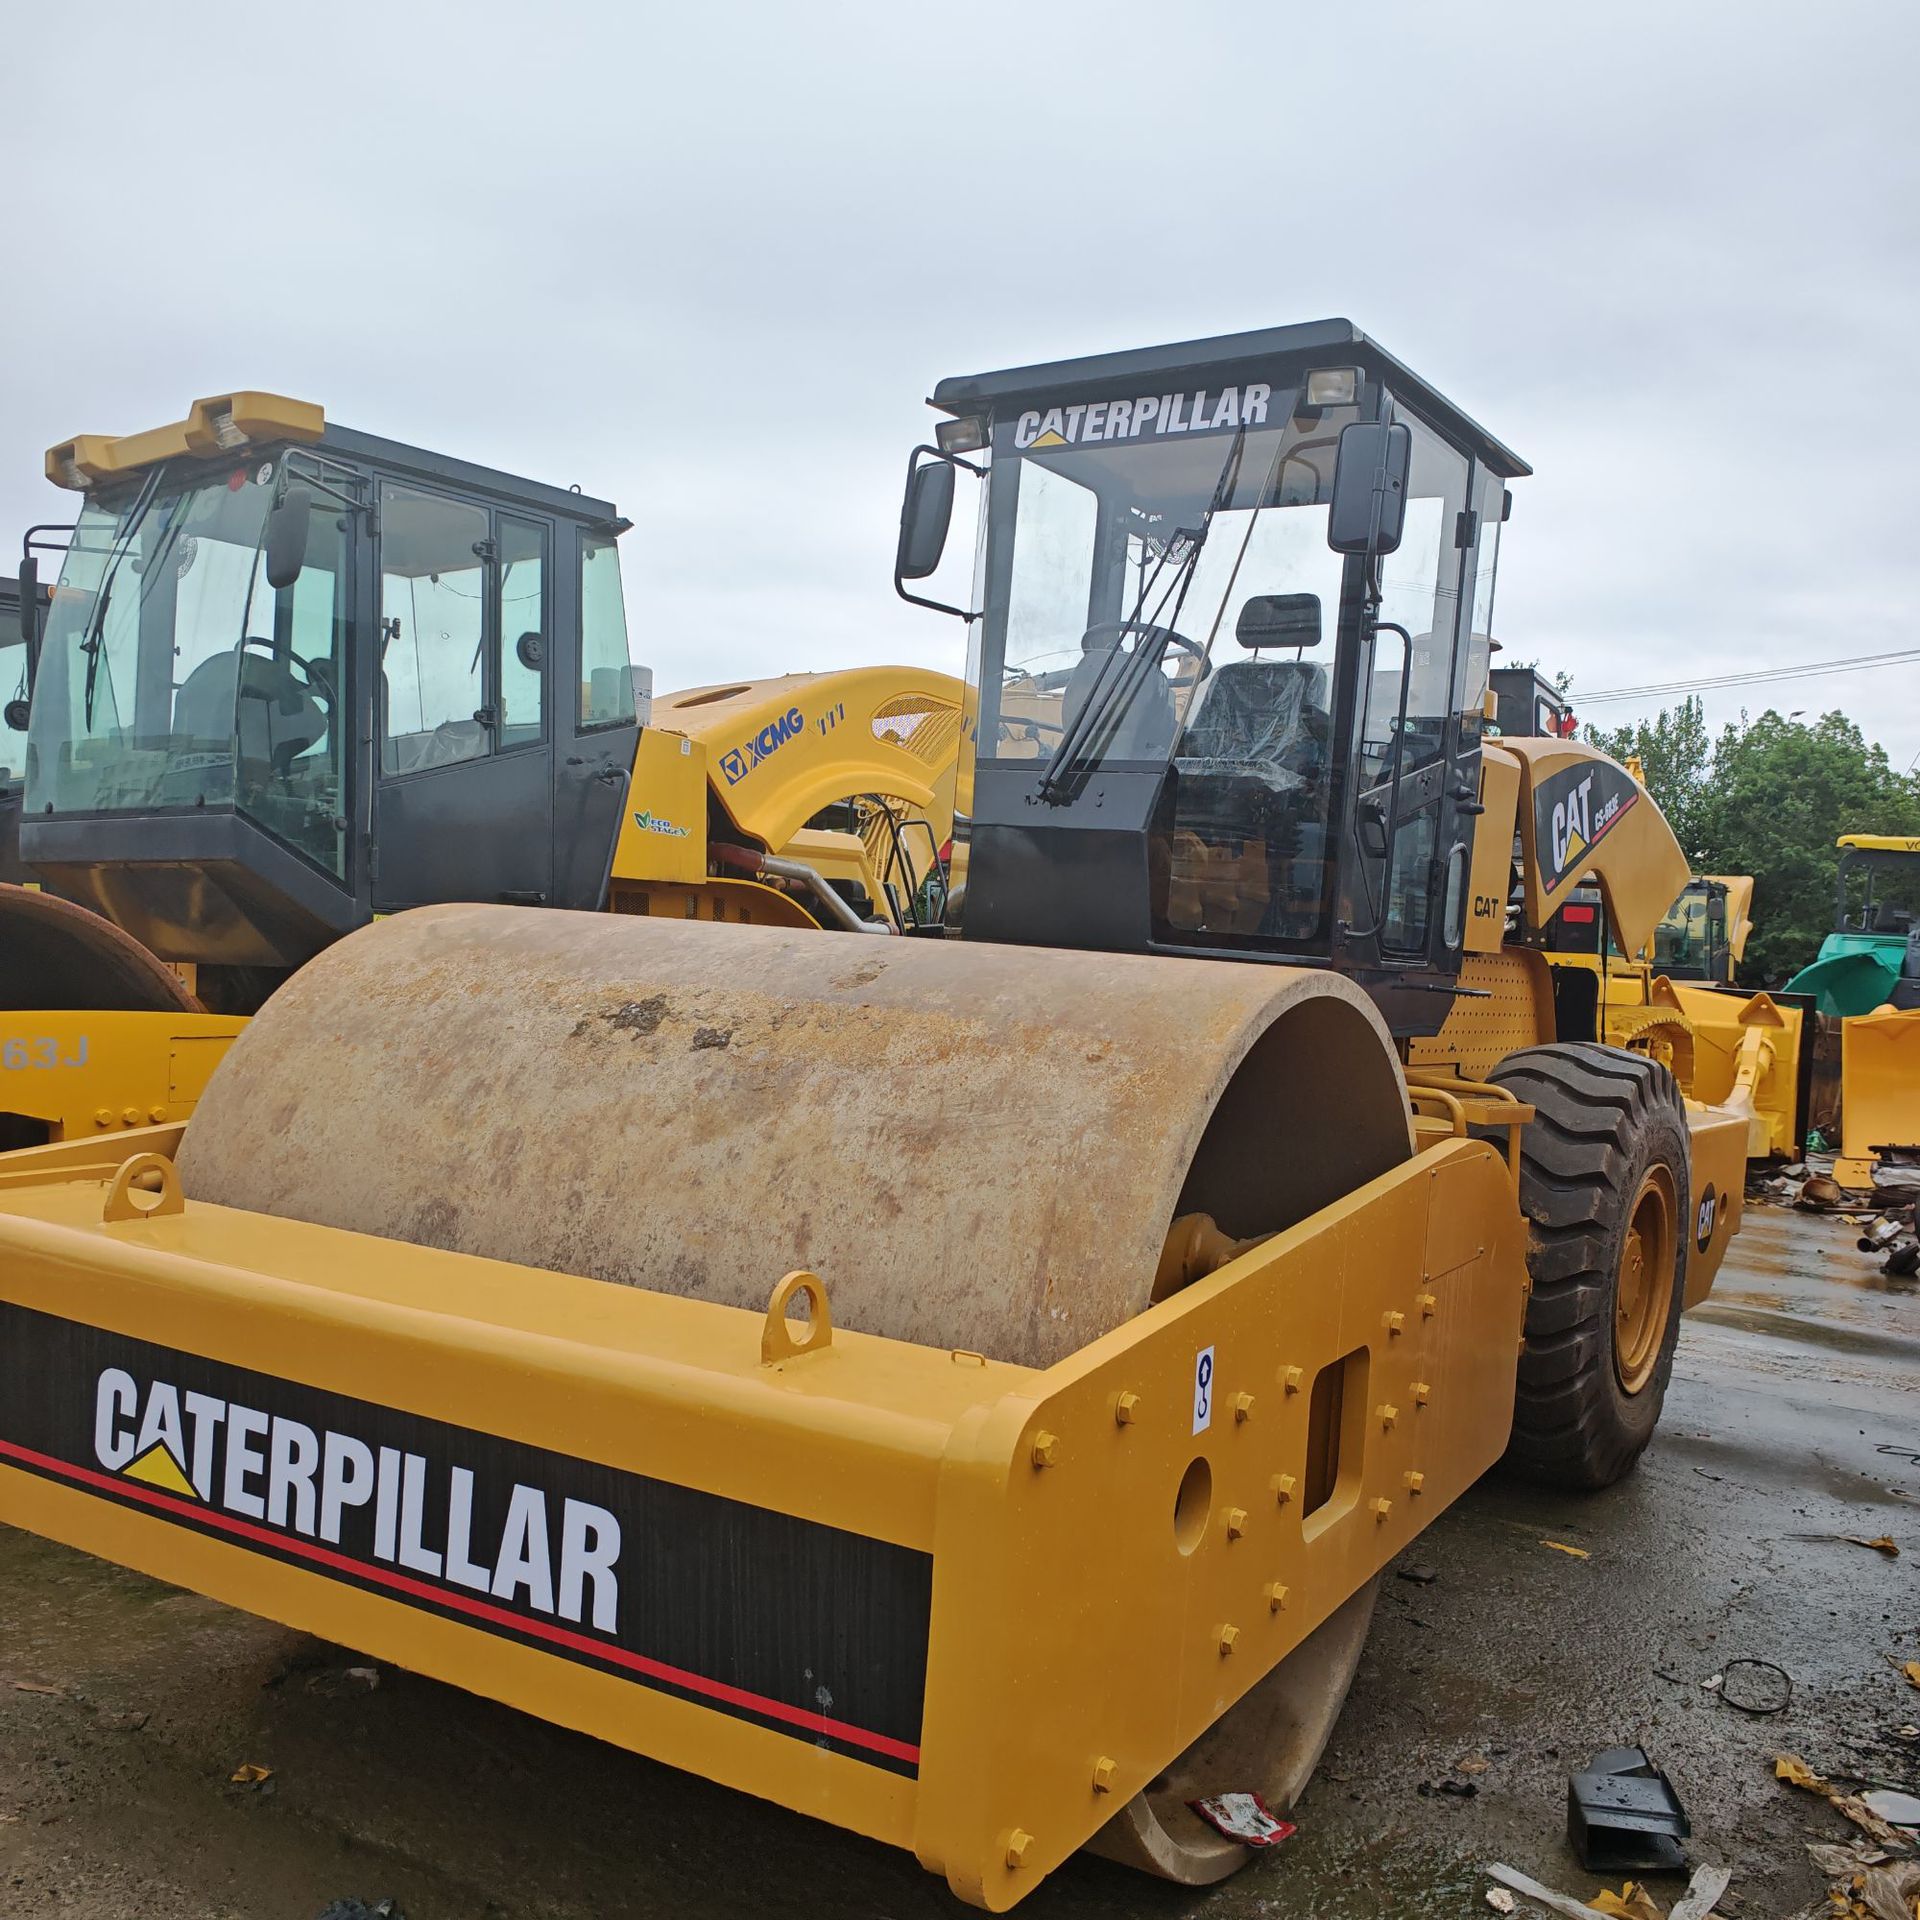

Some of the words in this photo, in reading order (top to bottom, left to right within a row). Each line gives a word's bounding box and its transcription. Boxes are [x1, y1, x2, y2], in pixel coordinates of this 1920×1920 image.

[1014, 384, 1271, 449] CATERPILLAR
[744, 707, 804, 771] XCMG
[651, 819, 670, 827] ECO
[1552, 776, 1591, 873] CAT
[1474, 895, 1499, 919] CAT
[2, 1035, 89, 1071] 63J
[1697, 1199, 1715, 1240] CAT
[95, 1367, 621, 1635] CATERPILLAR
